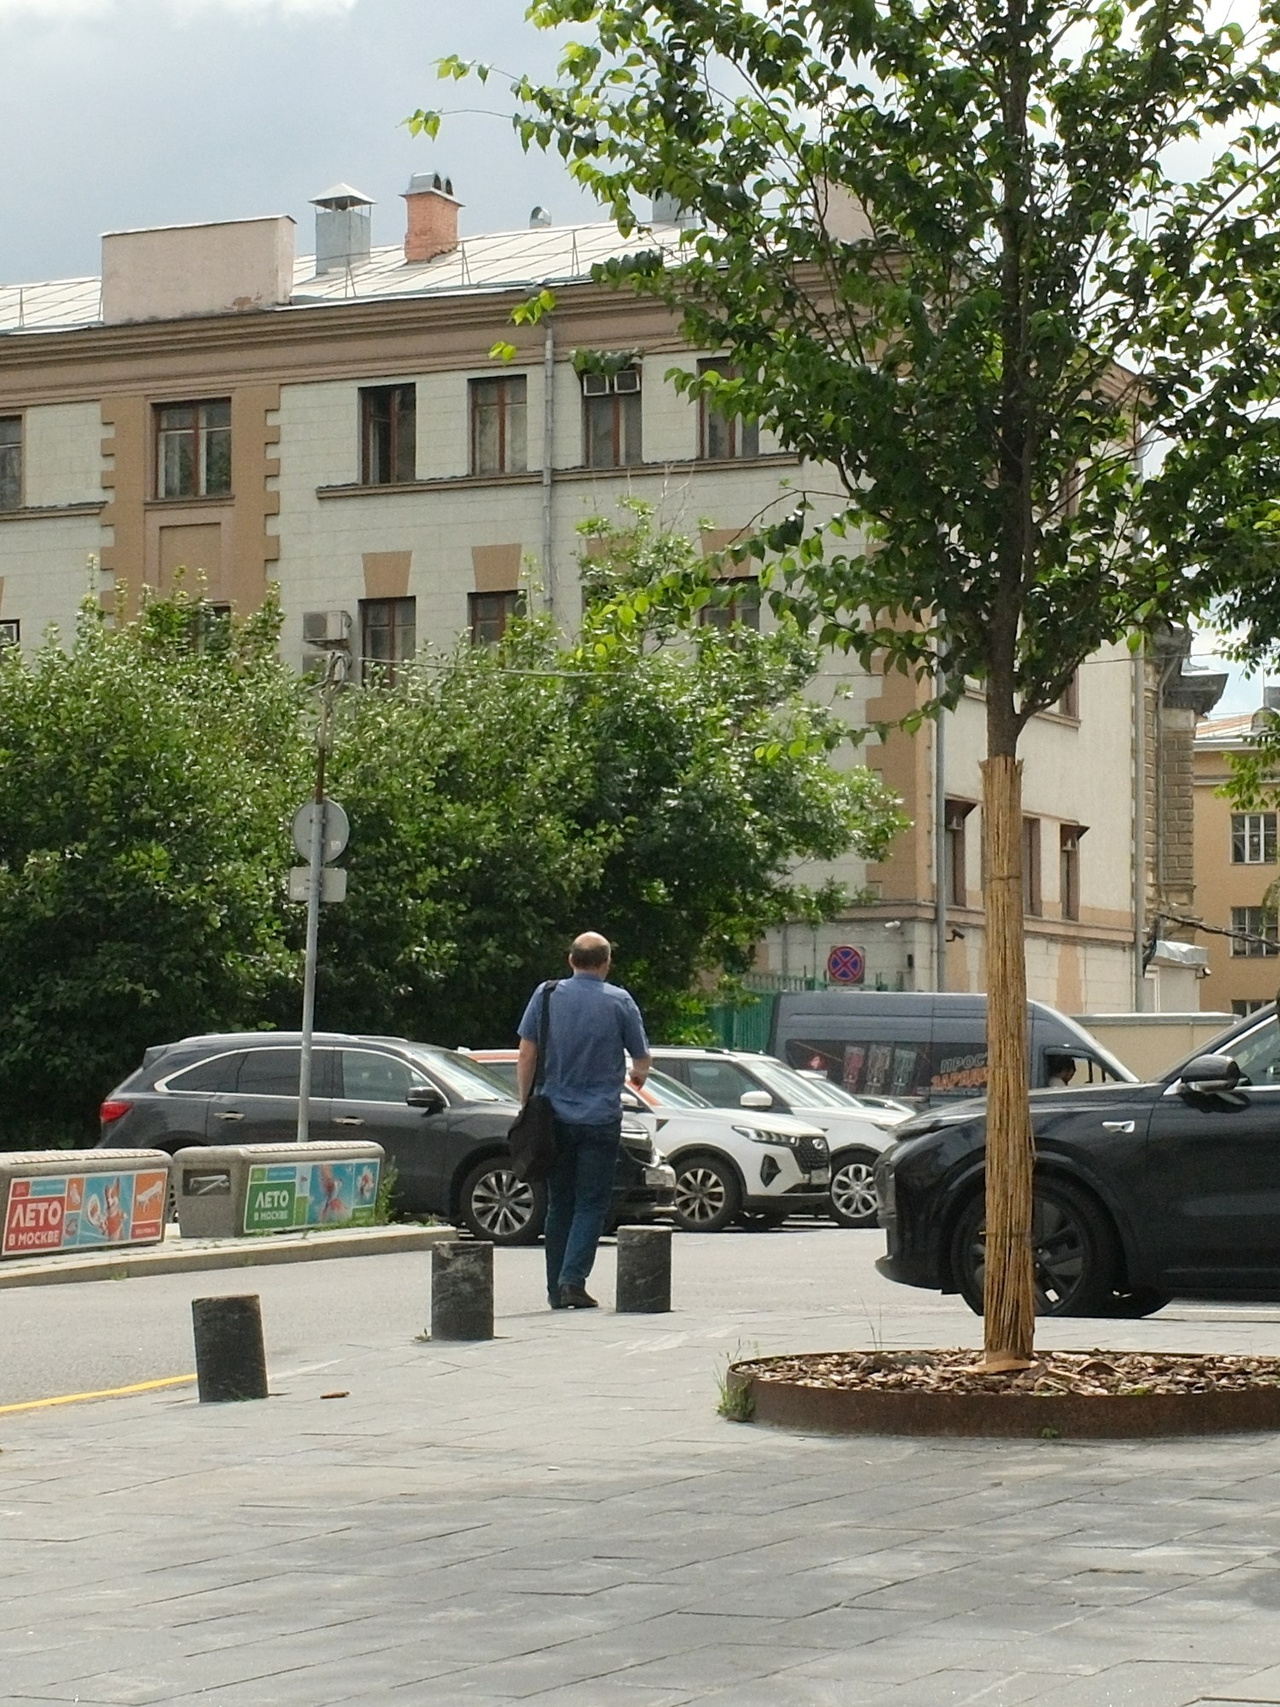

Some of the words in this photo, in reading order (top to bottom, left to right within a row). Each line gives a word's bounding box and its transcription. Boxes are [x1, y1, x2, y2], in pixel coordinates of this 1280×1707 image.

[940, 1052, 987, 1073] ПРОС
[255, 1190, 289, 1208] ЛЕТО
[10, 1201, 62, 1228] ЛЕТО
[254, 1212, 259, 1221] В
[260, 1210, 289, 1221] МОСКВЕ
[8, 1233, 16, 1246] В
[18, 1230, 60, 1246] МОСКВЕ
